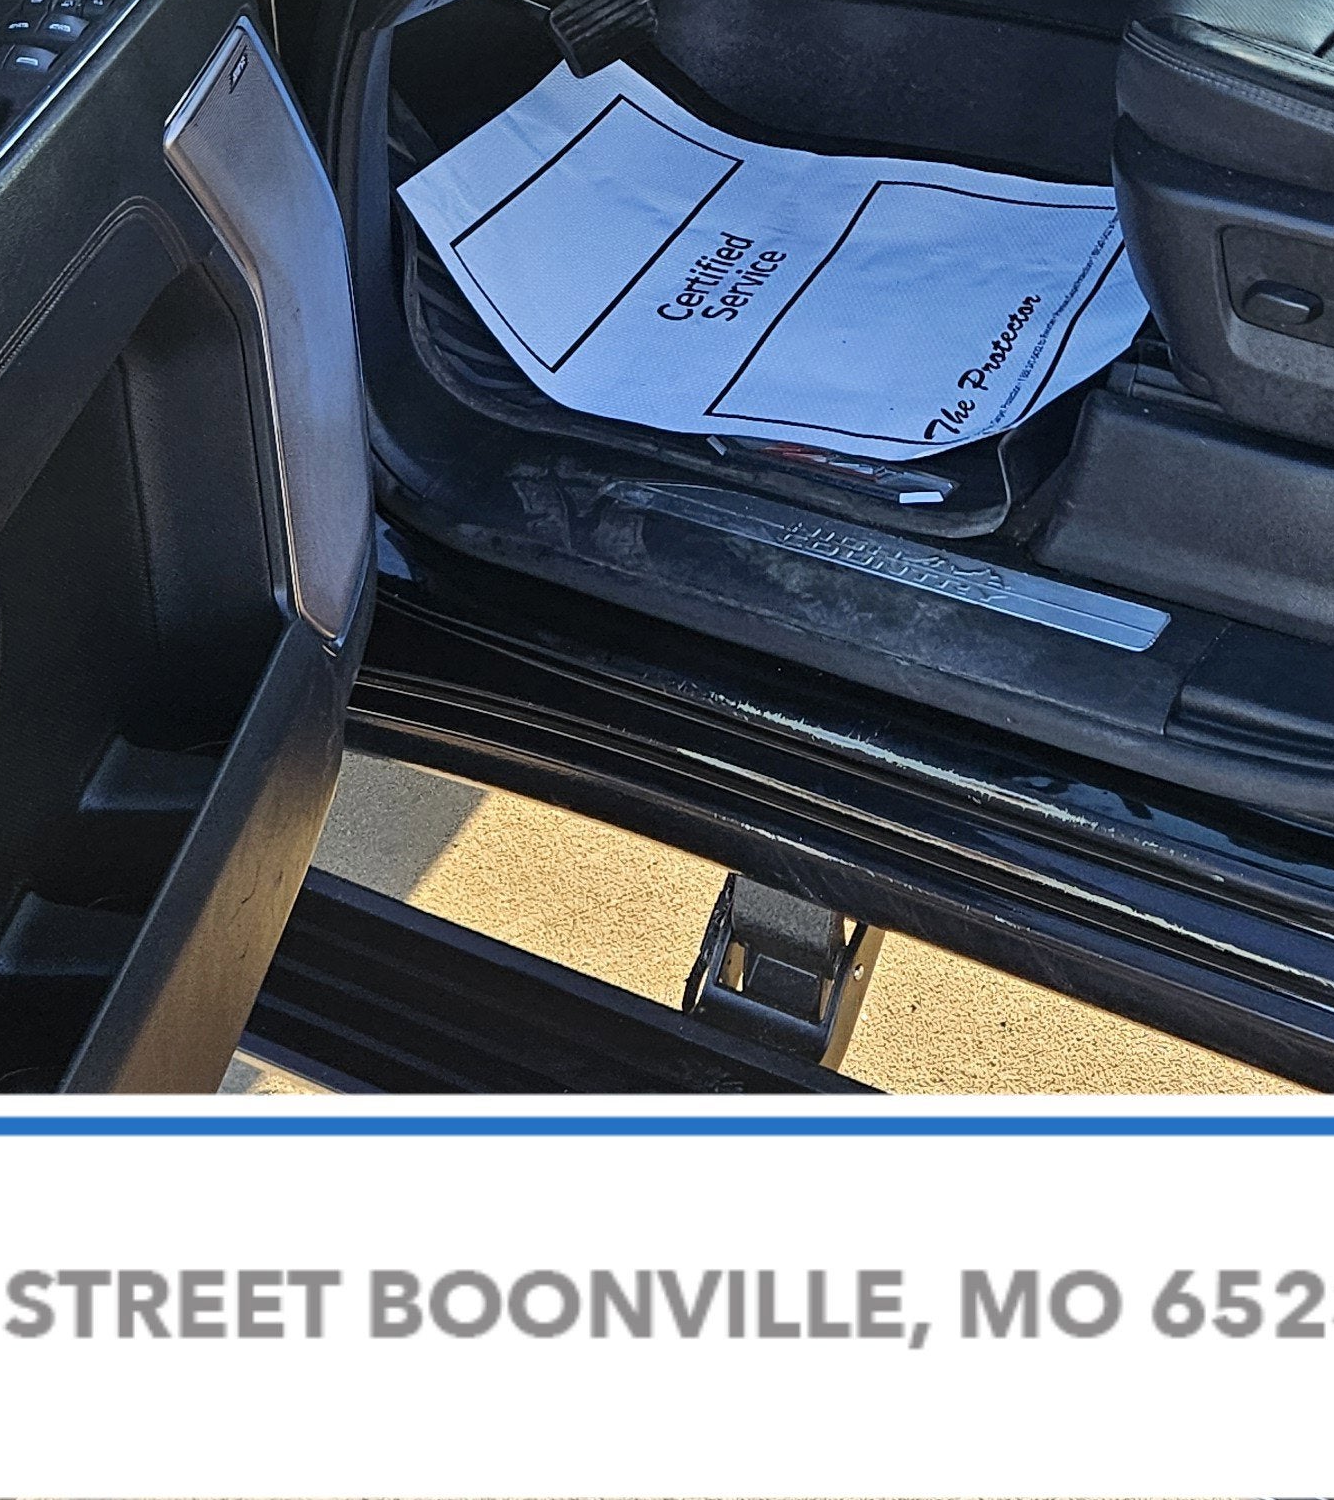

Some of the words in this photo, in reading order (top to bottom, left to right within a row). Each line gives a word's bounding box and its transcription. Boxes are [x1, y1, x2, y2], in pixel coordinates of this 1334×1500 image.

[656, 230, 756, 322] Certified
[700, 250, 788, 322] Service
[923, 399, 976, 441] The
[957, 292, 1043, 391] Protector
